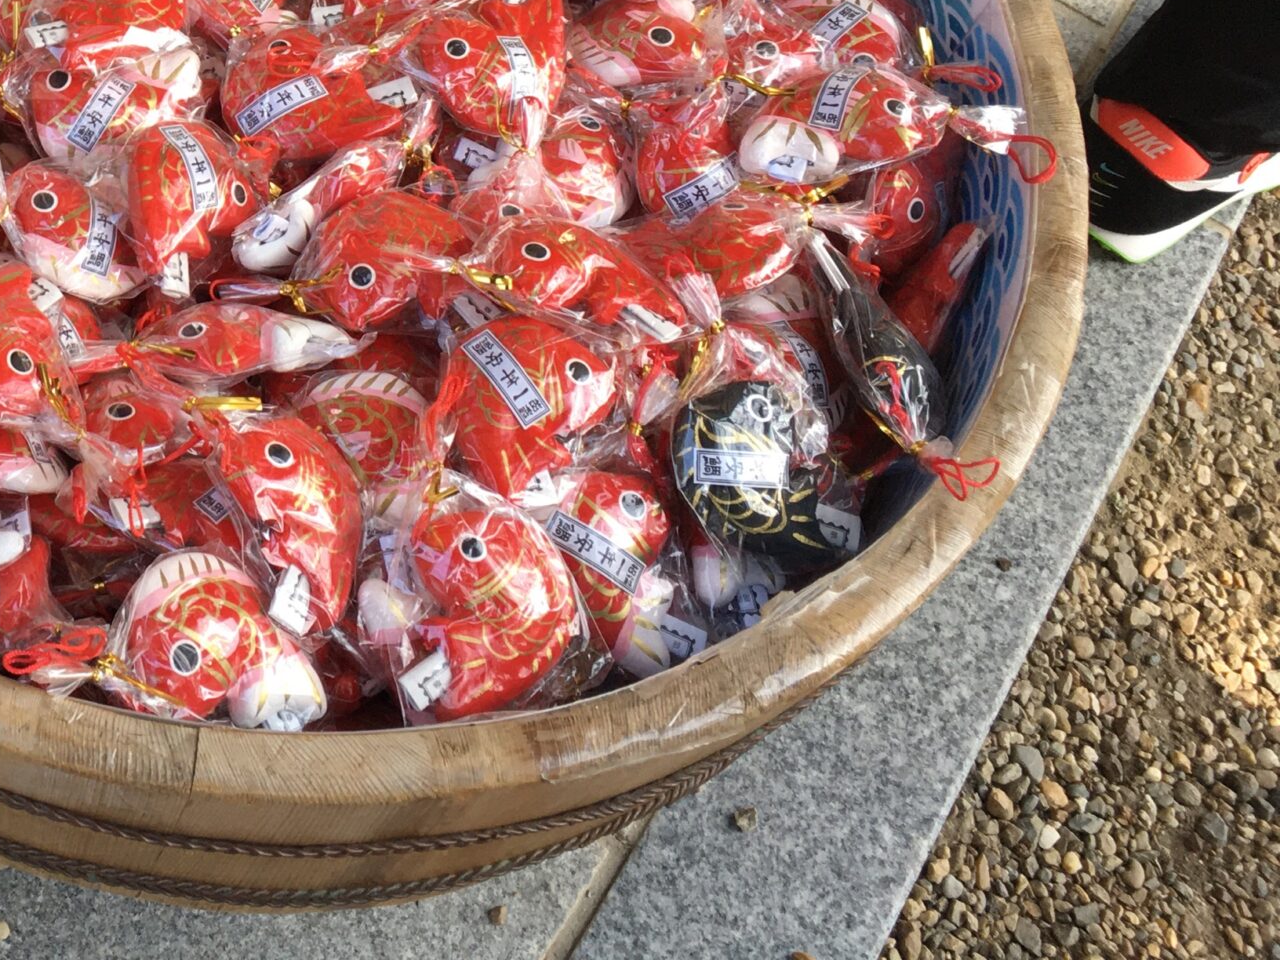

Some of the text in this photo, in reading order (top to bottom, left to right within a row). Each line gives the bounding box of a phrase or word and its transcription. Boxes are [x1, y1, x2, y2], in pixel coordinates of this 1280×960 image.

[1119, 118, 1175, 159] NIKE
[471, 336, 530, 403] 一年安鯛
[550, 516, 626, 577] 一年安鯛
